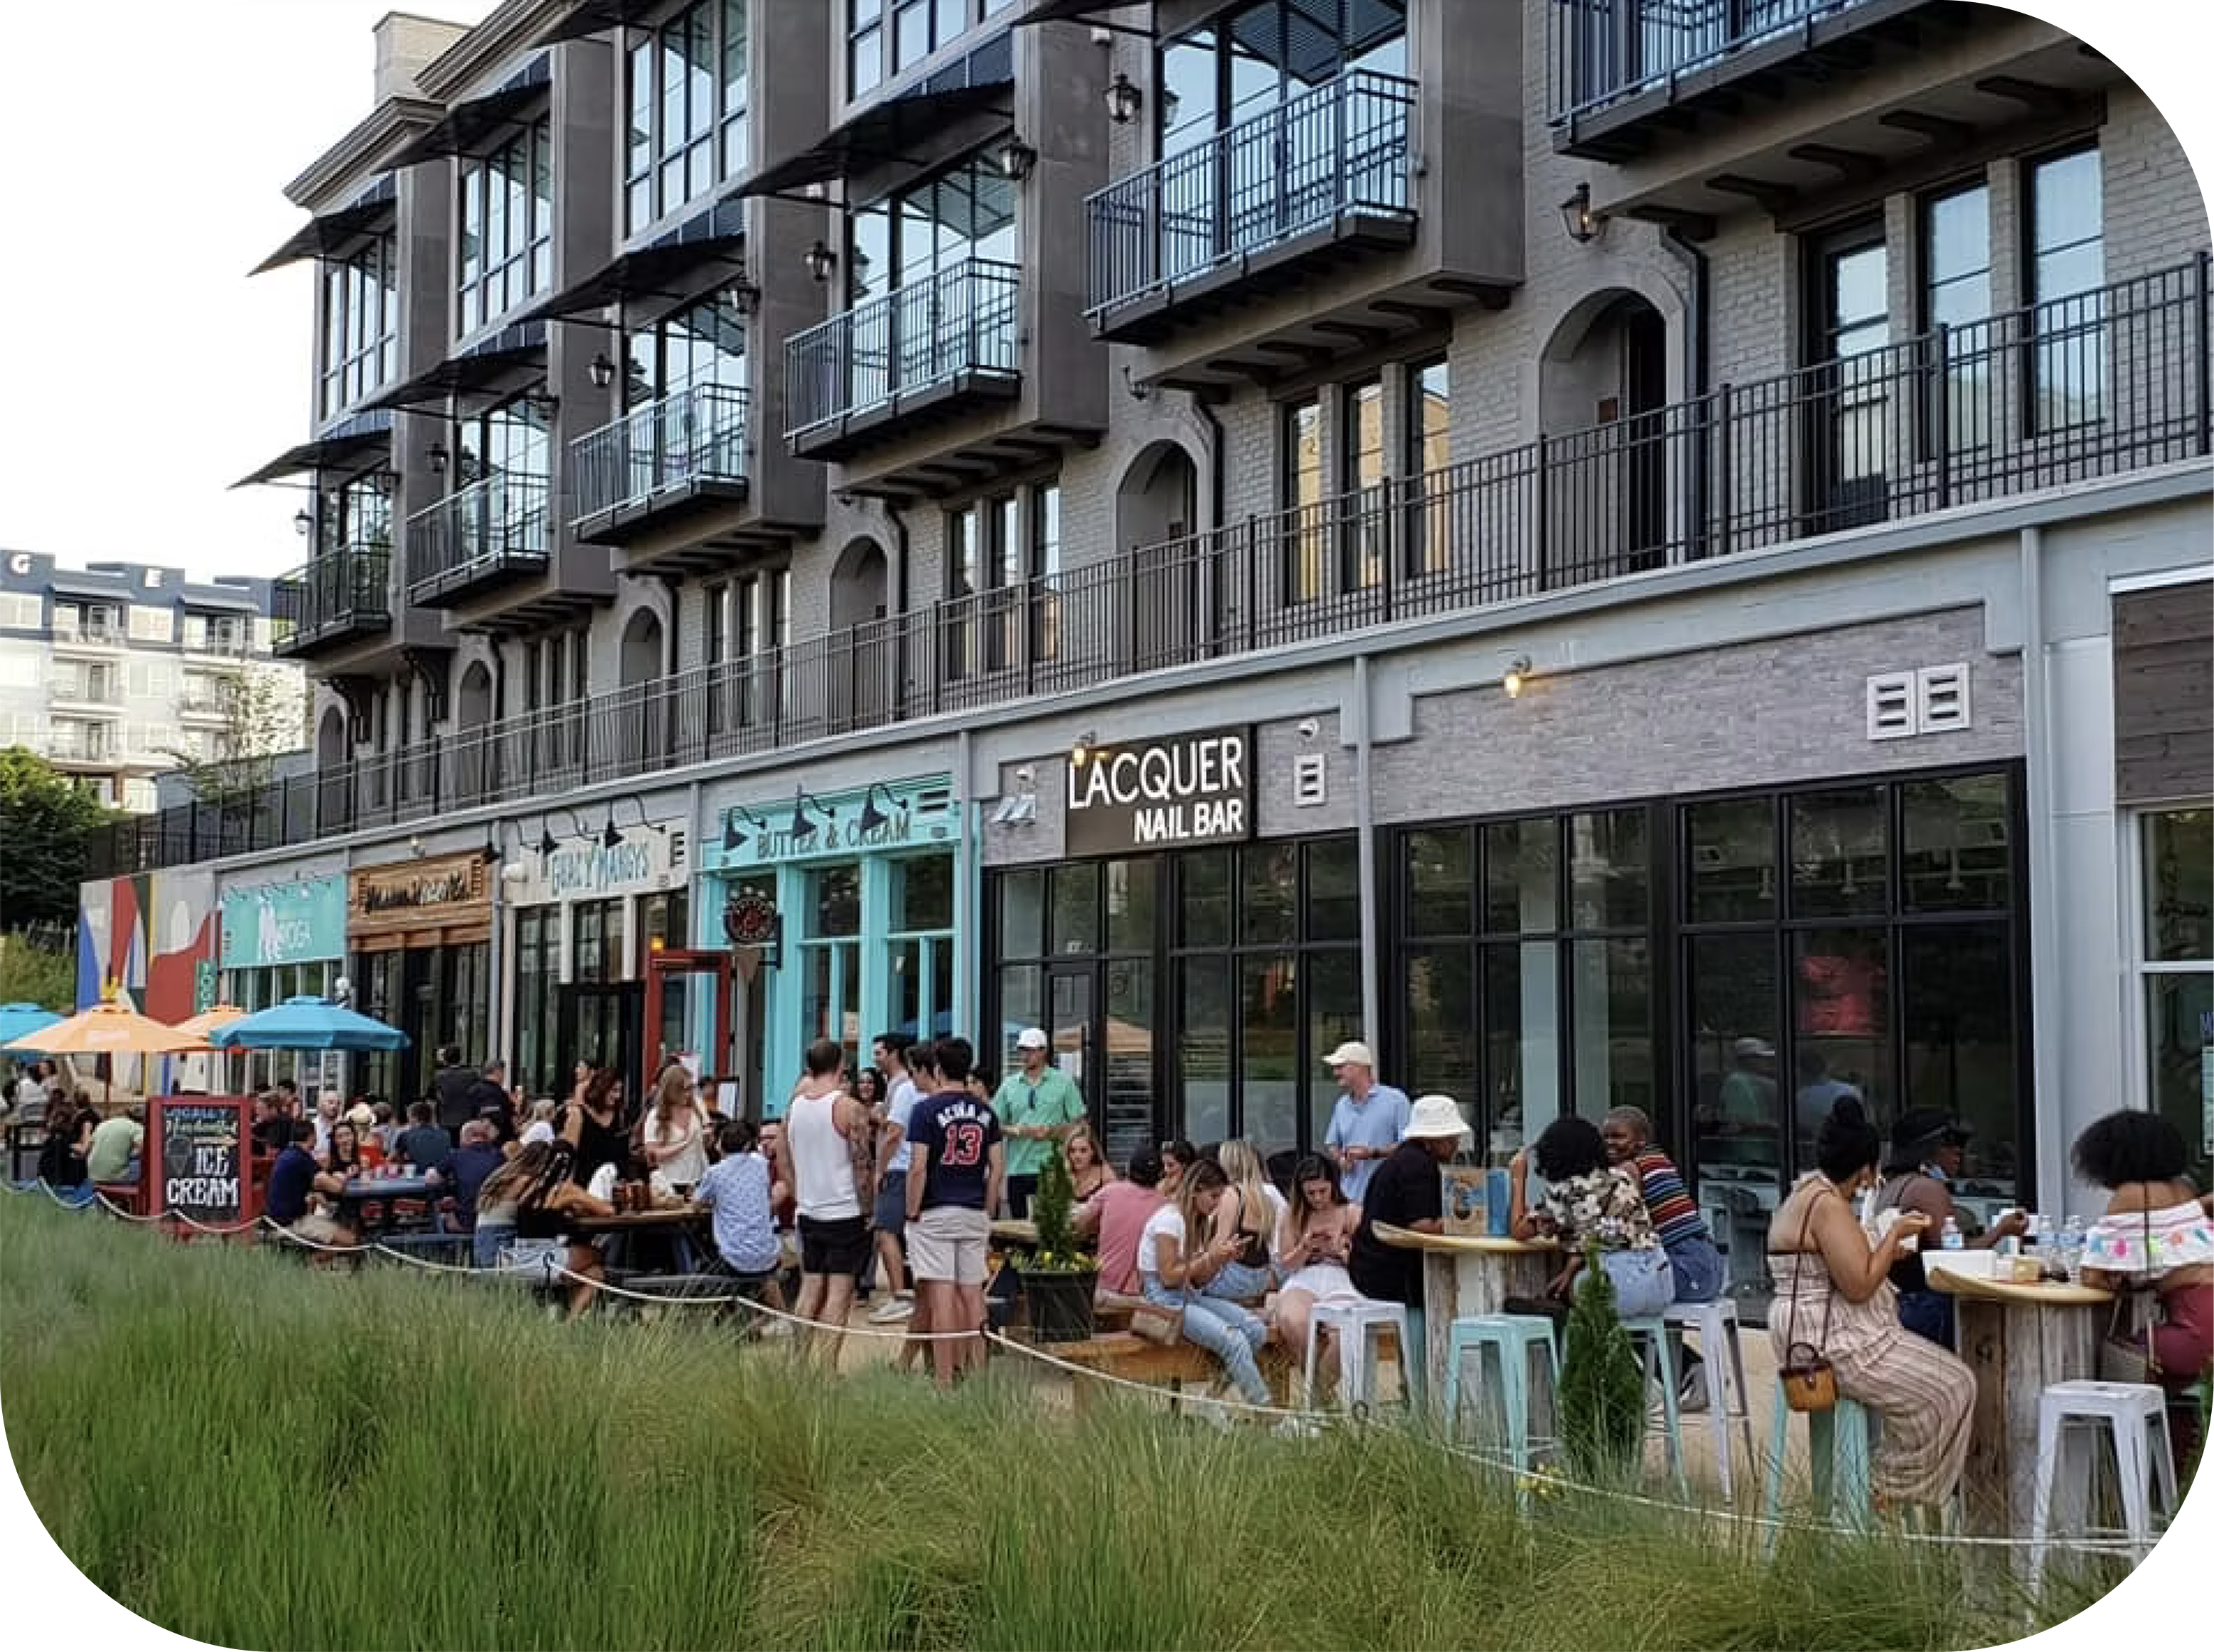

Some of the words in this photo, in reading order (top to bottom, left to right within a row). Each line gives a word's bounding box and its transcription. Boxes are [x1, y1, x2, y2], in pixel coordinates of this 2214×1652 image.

[1068, 736, 1244, 810] LACQUER
[826, 822, 839, 849] &
[1133, 805, 1190, 844] NAIL
[1194, 798, 1244, 837] BAR
[195, 1147, 230, 1176] ICE
[941, 1122, 984, 1166] 13
[166, 1176, 240, 1207] CREAM
